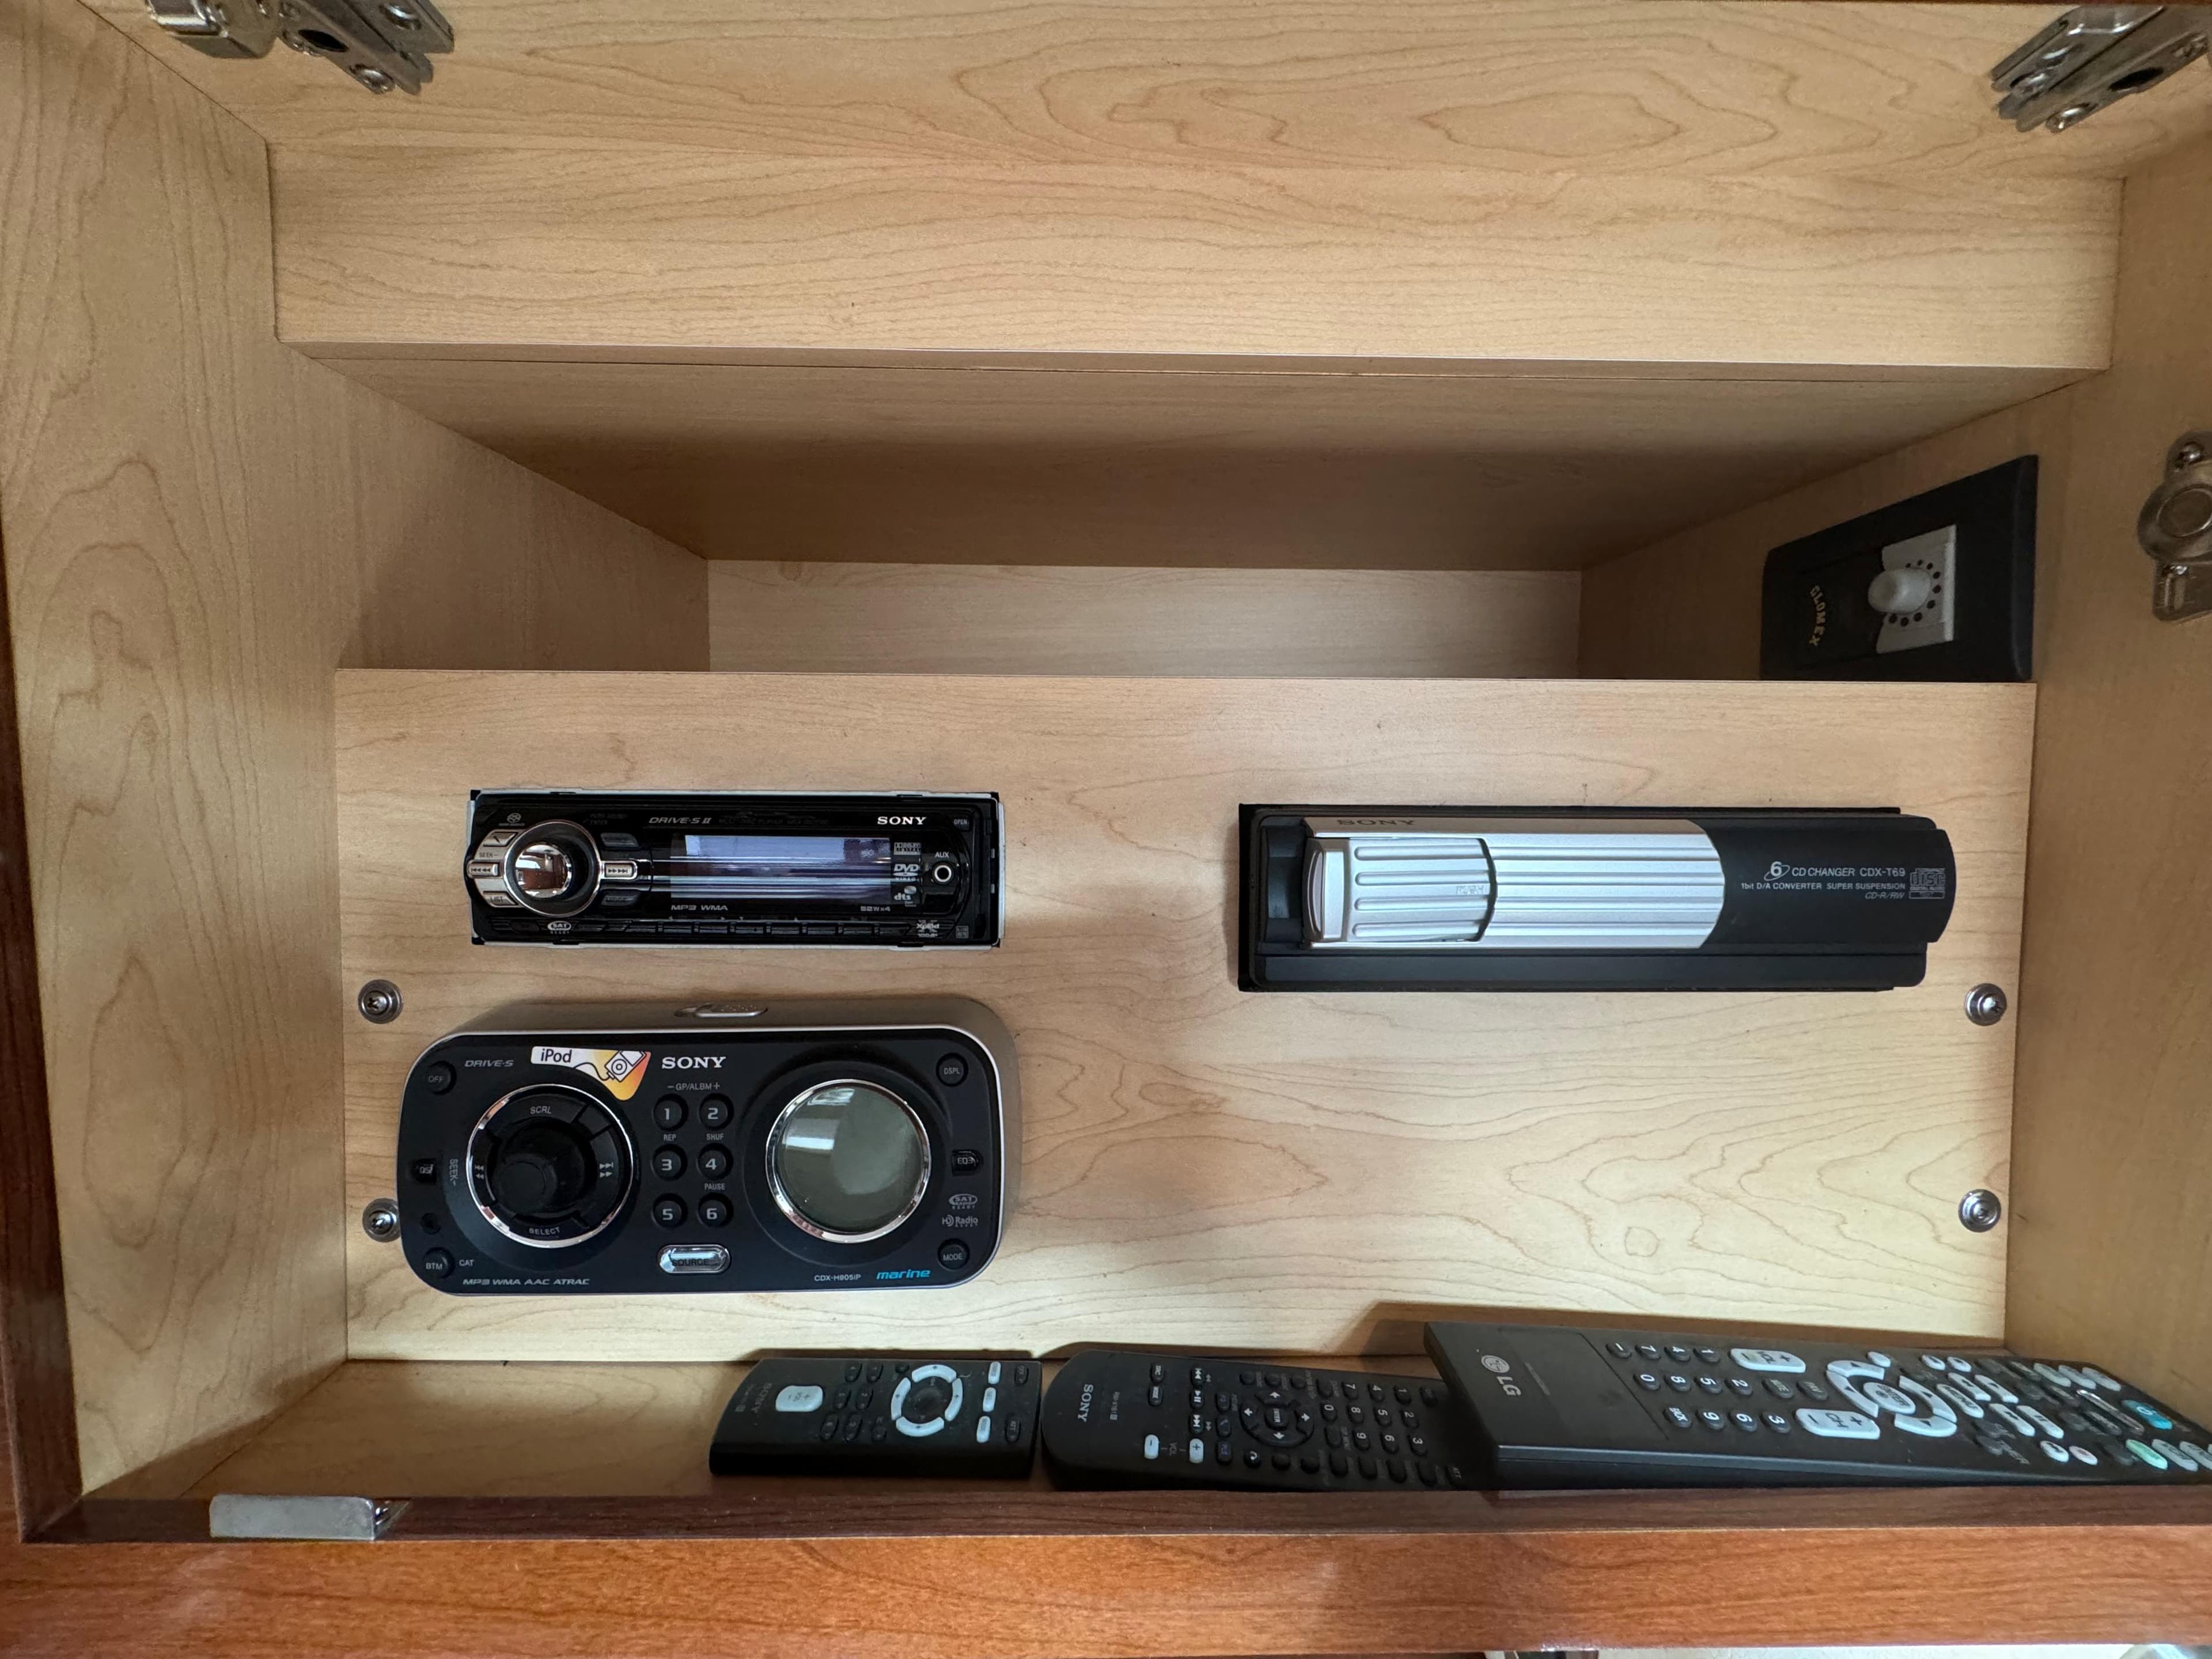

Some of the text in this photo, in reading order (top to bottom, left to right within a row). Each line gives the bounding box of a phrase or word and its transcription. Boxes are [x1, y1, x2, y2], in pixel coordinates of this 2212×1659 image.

[877, 816, 927, 825] SONY
[893, 863, 920, 872] DVD
[1770, 861, 1906, 877] 6 CD CHANGER CDX-T69
[540, 1048, 573, 1063] iPod
[661, 1056, 727, 1069] SONY
[944, 1067, 960, 1075] DSPL
[529, 1105, 552, 1115] SCRL
[664, 1107, 719, 1120] 1 2
[663, 1133, 724, 1142] REP SHUF
[661, 1158, 717, 1171] 3 4
[704, 1183, 726, 1191] PAUSE
[662, 1208, 718, 1221] 5 6
[955, 1215, 979, 1224] Radio
[528, 1226, 560, 1236] SELECT
[942, 1253, 963, 1262] MODE
[425, 1262, 443, 1270] BTM
[876, 1269, 931, 1280] marine
[1496, 1376, 1522, 1396] LG
[1640, 1374, 1655, 1382] 0
[1731, 1378, 1748, 1387] 2
[1077, 1384, 1094, 1422] SONY
[1703, 1411, 1785, 1425] 9 6 3
[1356, 1431, 1367, 1440] 9
[1169, 1442, 1178, 1456] VOL
